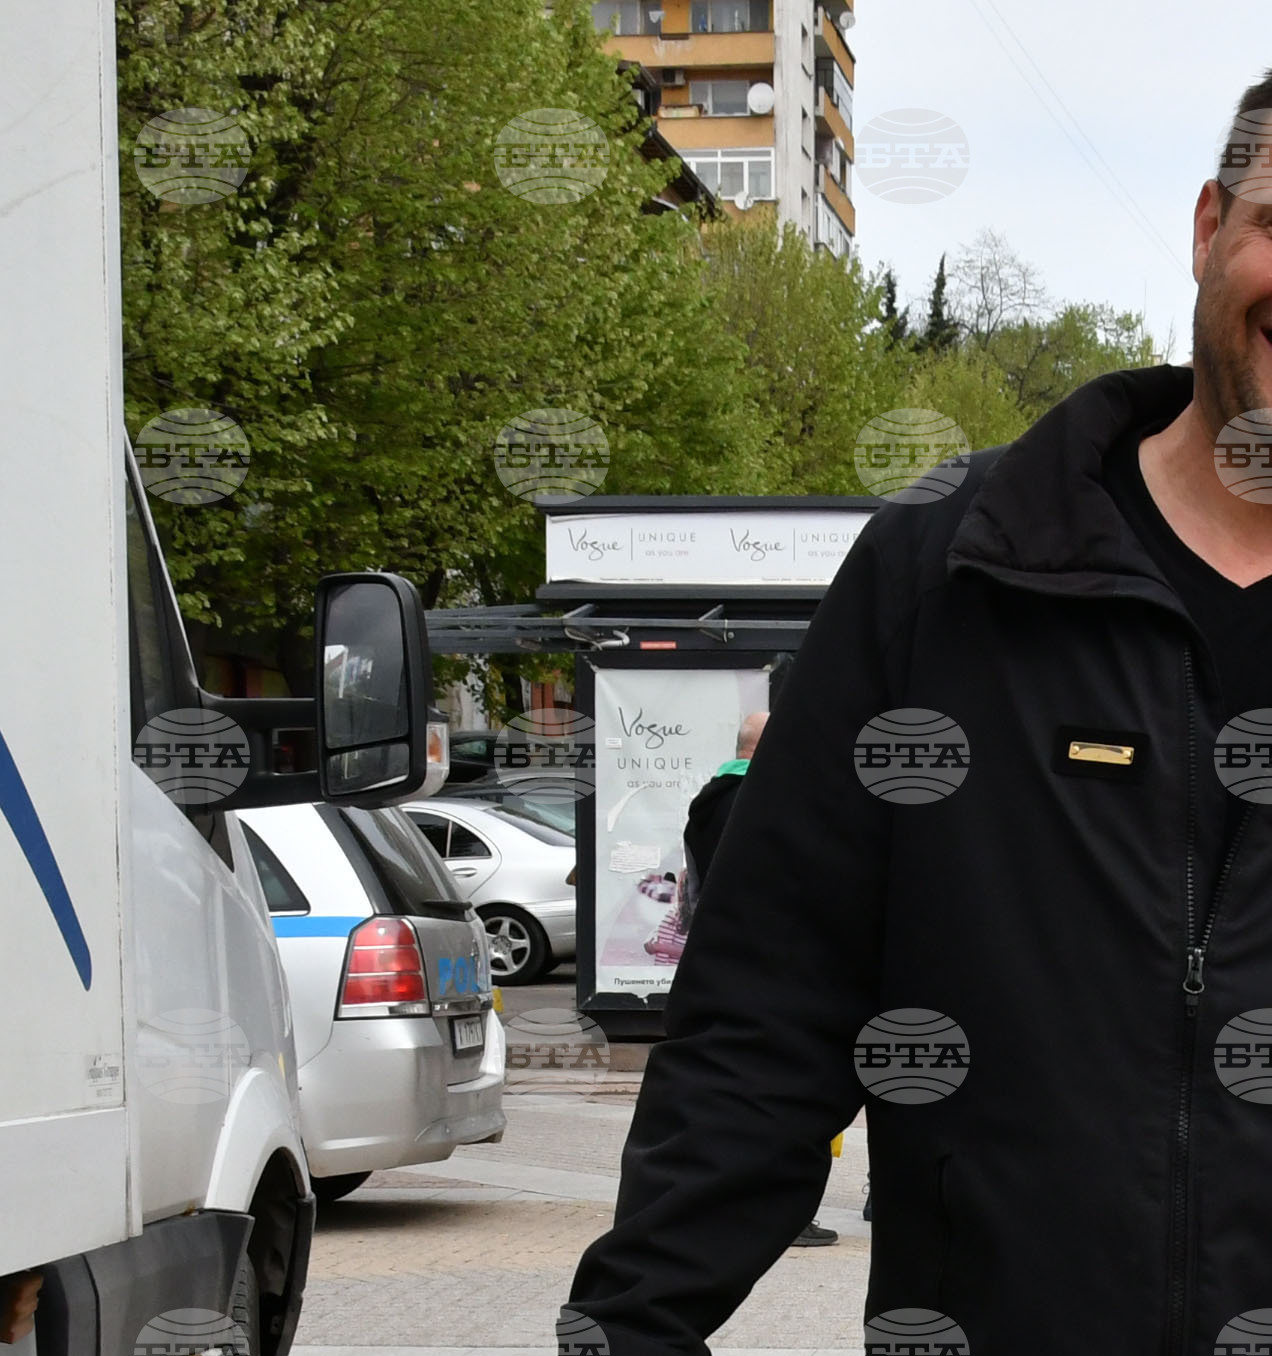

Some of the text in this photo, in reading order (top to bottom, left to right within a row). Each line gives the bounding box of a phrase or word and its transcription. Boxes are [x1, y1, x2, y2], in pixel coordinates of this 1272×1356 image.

[568, 527, 622, 561] Vogue
[638, 532, 696, 542] UNIQUE
[730, 527, 785, 562] Vogue
[618, 706, 692, 750] Vogue
[617, 757, 693, 770] UNIQUE
